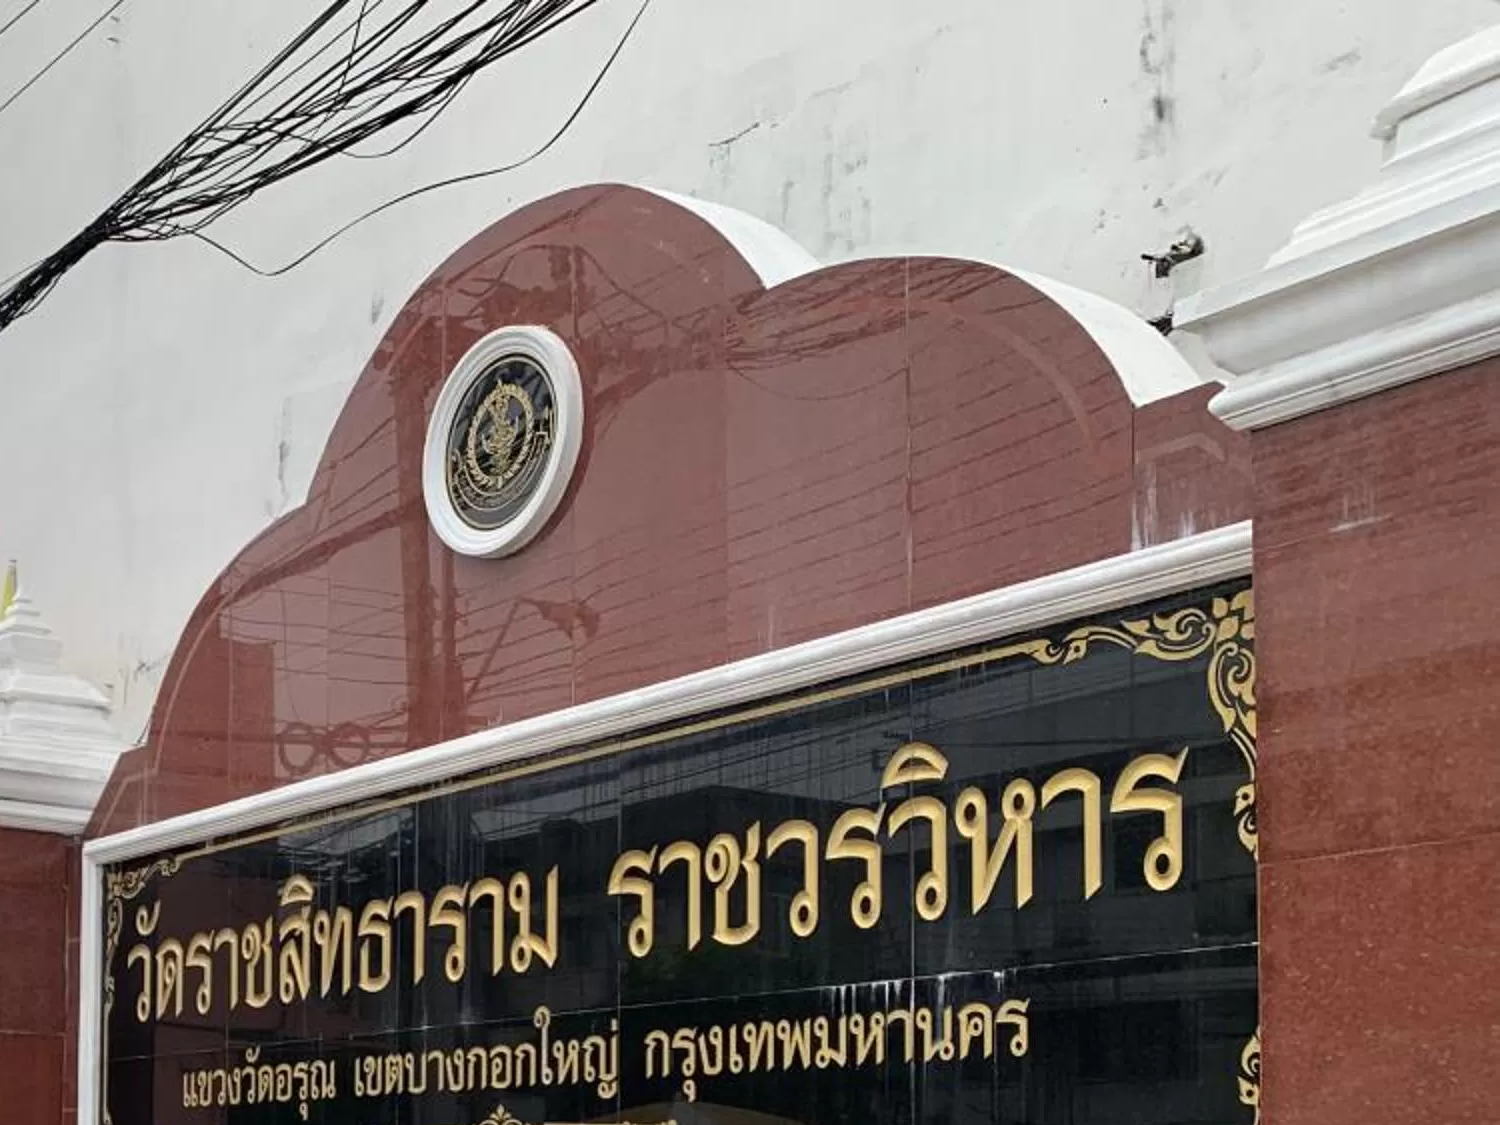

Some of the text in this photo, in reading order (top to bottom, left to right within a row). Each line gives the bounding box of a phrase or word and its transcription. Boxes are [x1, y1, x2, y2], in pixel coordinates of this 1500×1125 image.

[127, 741, 1190, 1023] วัดราชสิทธาราม ราชวรวิหาร
[182, 997, 1031, 1121] แขวงวัดอรุณ เขตบางกอกใหญ่ กรุงเทพมหานคร
